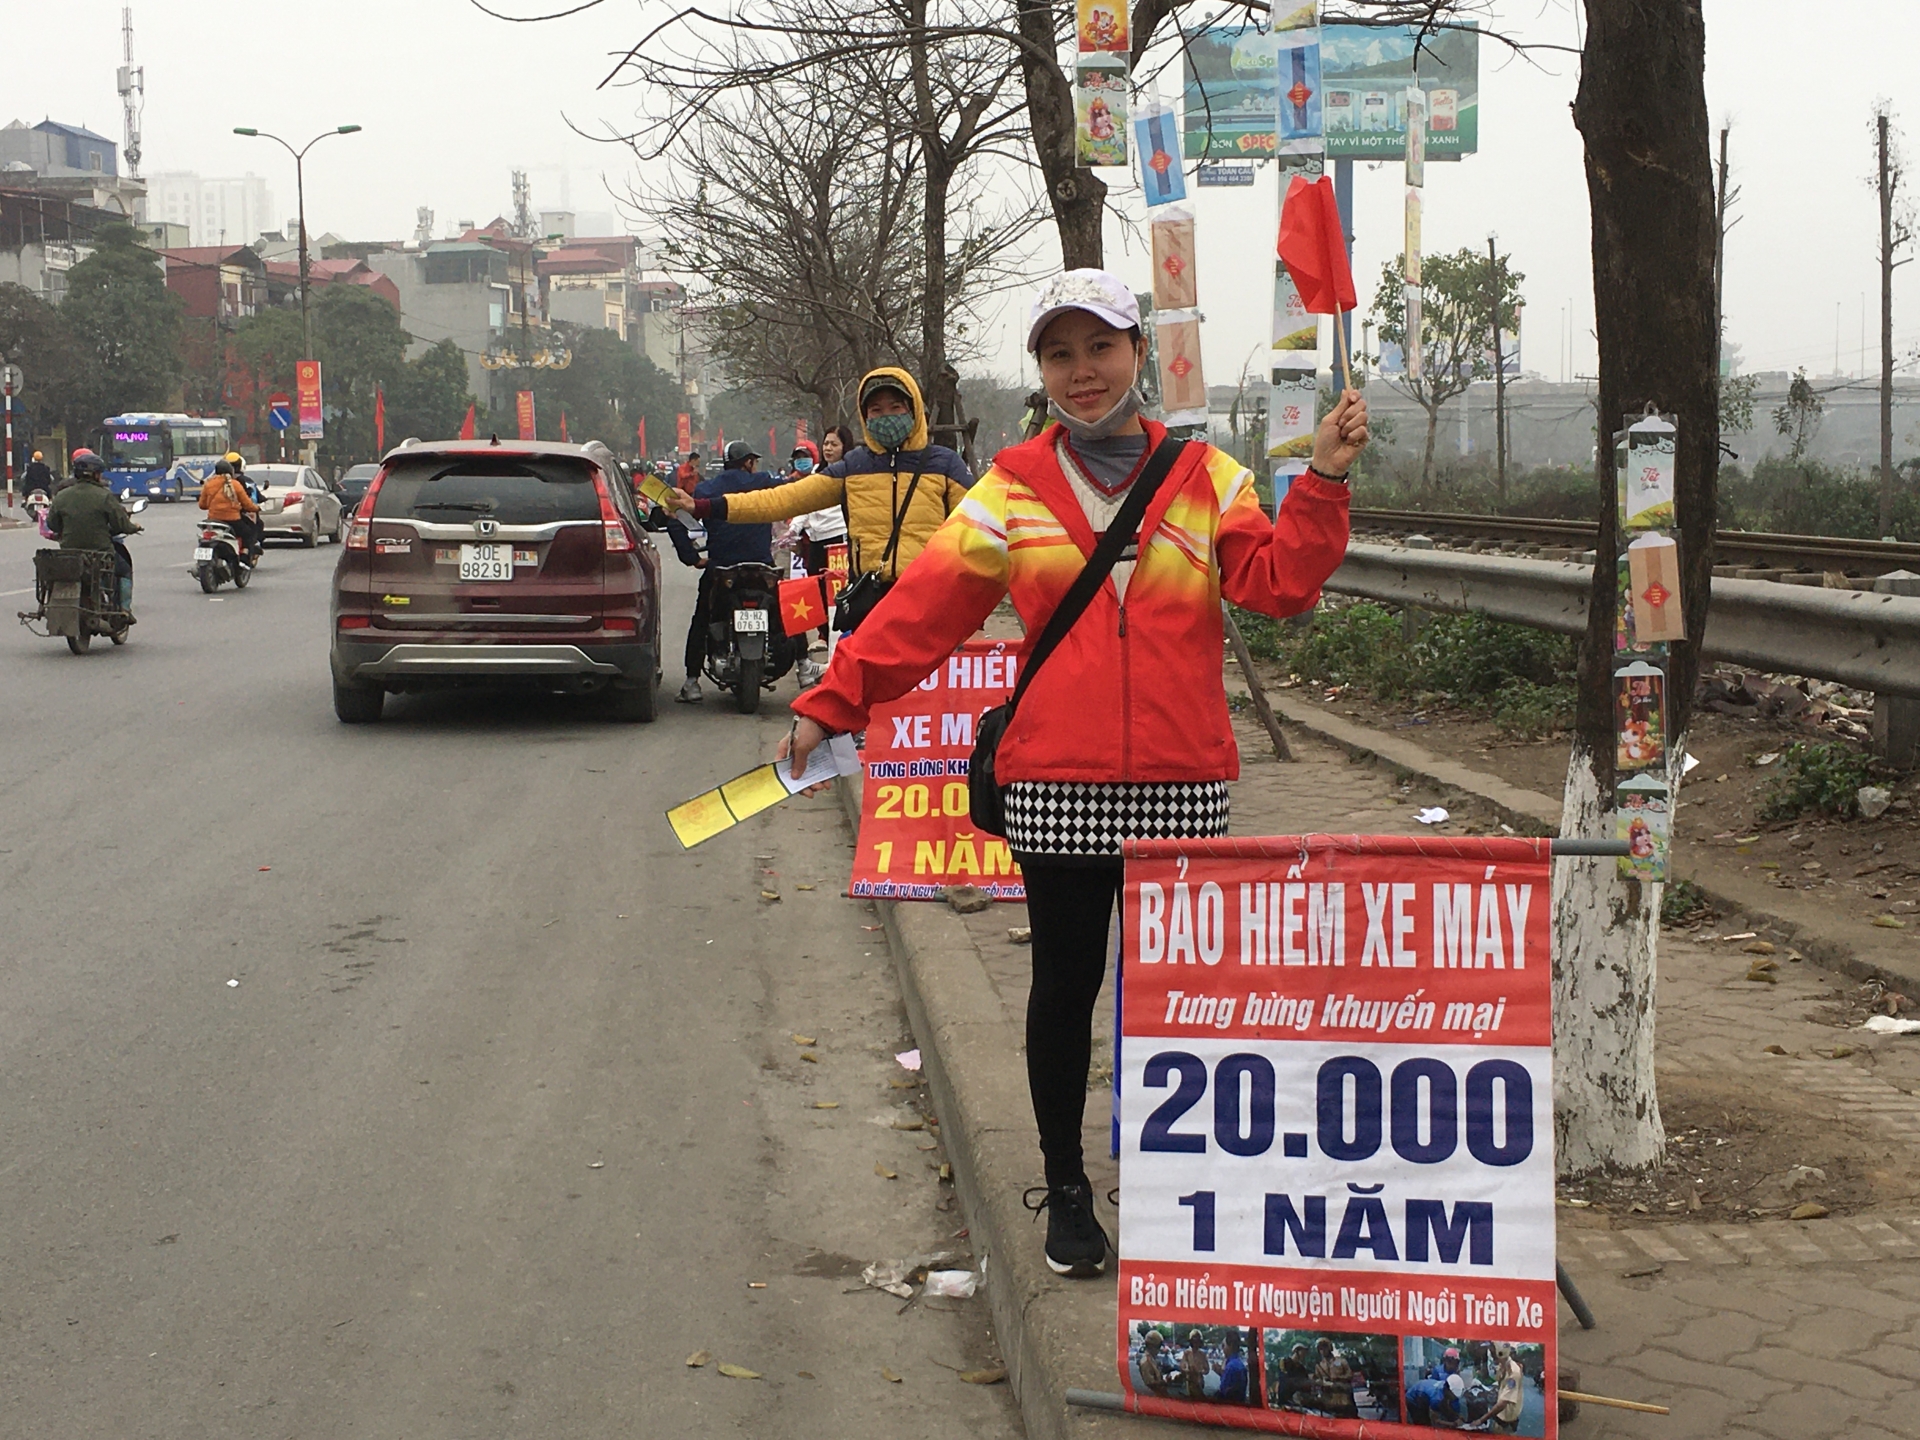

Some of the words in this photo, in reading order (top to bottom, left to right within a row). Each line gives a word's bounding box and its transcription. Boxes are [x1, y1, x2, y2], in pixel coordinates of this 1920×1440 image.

[1328, 137, 1346, 146] TAY
[1362, 136, 1383, 147] MỘT
[1431, 135, 1460, 145] XANH
[461, 562, 512, 579] 982.91
[473, 545, 501, 561] 30E
[891, 715, 931, 749] XE
[909, 758, 943, 777] BỪNG
[873, 841, 893, 873] 1
[913, 832, 1023, 876] NĂM
[1139, 855, 1224, 966] BẢO
[1239, 849, 1346, 968] HIỂM
[1360, 881, 1417, 969] XE
[1432, 865, 1533, 970] MÁY
[1163, 990, 1237, 1030] Tưng
[1243, 990, 1316, 1032] bừng
[1320, 988, 1436, 1032] khuyến
[1441, 996, 1507, 1039] mại
[1139, 1050, 1534, 1167] 20.000
[1178, 1190, 1216, 1252] 1
[1262, 1182, 1494, 1266] NĂM
[1129, 1274, 1169, 1308] Bảo
[1175, 1271, 1228, 1311] Hiểm
[1233, 1280, 1256, 1319] Tự
[1259, 1283, 1334, 1323] Nguyện
[1340, 1287, 1401, 1323] Người
[1407, 1288, 1457, 1327] Ngồi
[1463, 1292, 1509, 1328] Trên
[1515, 1295, 1544, 1329] Xe
